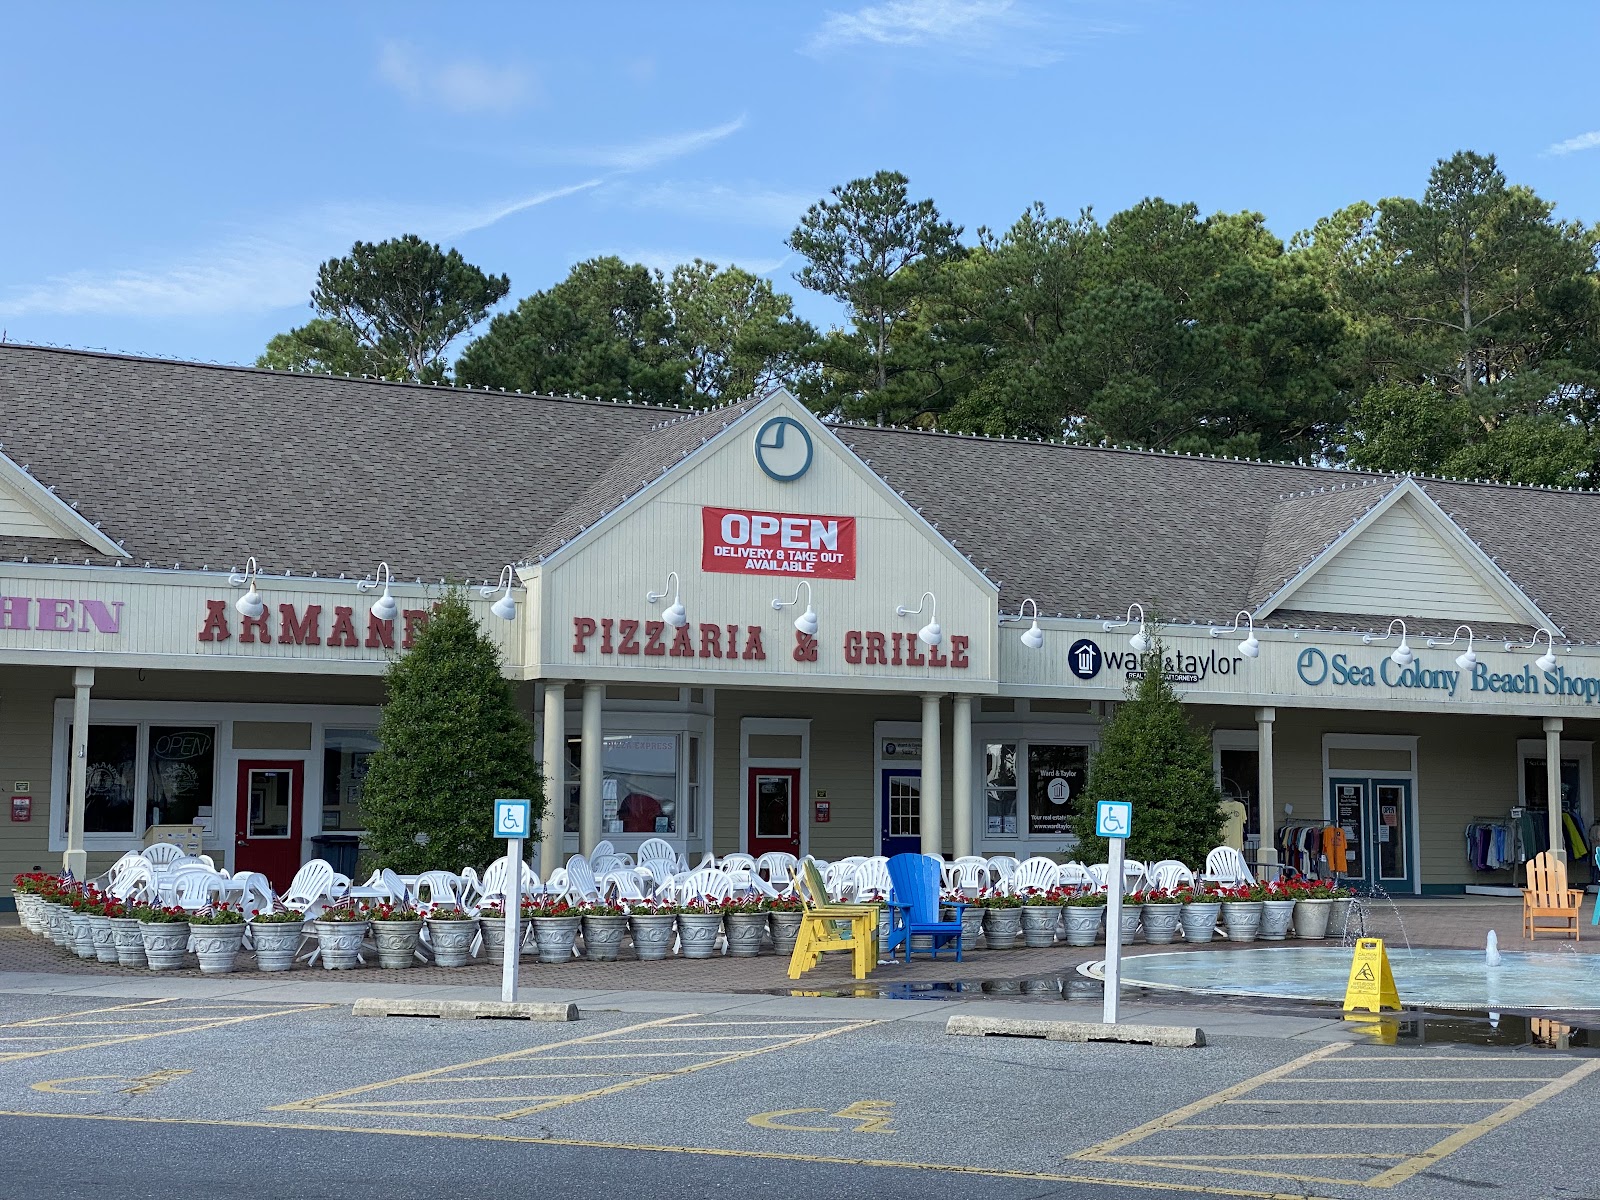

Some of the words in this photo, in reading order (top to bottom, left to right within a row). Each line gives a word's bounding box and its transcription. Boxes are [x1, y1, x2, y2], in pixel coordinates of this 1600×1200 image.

[721, 513, 838, 551] OPEN
[713, 545, 773, 560] DELIVERY
[776, 551, 785, 561] &
[788, 550, 818, 562] TAKE
[820, 552, 844, 563] OUT
[745, 558, 815, 573] AVAILABLE
[573, 616, 766, 660] PIZZARIA
[793, 629, 818, 662] &
[843, 630, 969, 668] GRILLE
[1164, 656, 1175, 672] &
[1176, 649, 1242, 680] taylor
[1331, 653, 1376, 687] Sea
[1380, 656, 1459, 697] Colony
[1471, 661, 1539, 693] Beach
[156, 735, 207, 755] OPEN
[635, 742, 673, 750] EXPRESS
[1060, 770, 1077, 778] Taylor
